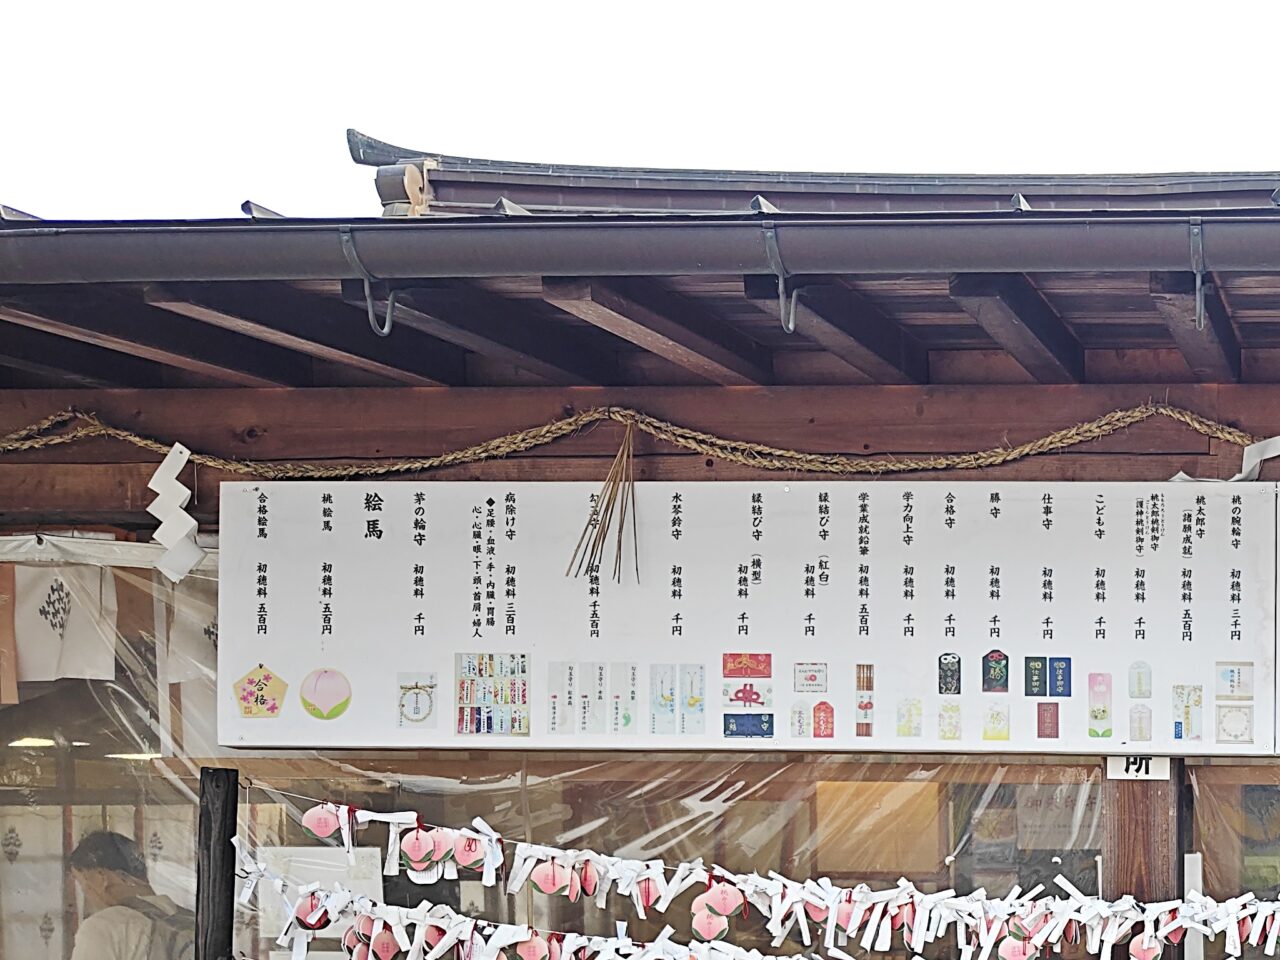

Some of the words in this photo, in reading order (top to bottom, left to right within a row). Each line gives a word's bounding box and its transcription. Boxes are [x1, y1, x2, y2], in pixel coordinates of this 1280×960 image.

[257, 492, 268, 538] 合格絵馬
[322, 493, 333, 531] 桃絵馬
[364, 493, 384, 539] 絵馬
[413, 492, 426, 546] 茅の輪守
[505, 492, 516, 540] 病除け守
[672, 492, 682, 540] 水琴鈴守
[752, 493, 763, 541] 縁結び守
[819, 492, 830, 540] 縁結び守
[902, 492, 913, 545] 学力向上守
[944, 492, 956, 528] 合格守
[990, 492, 1001, 518] 勝守
[1042, 493, 1053, 530] 仕事守
[1094, 495, 1106, 539] こども守
[1196, 496, 1206, 538] 桃太郎守
[1231, 495, 1242, 549] 桃の腕輪守
[858, 493, 870, 556] 学業成就鉛筆
[256, 563, 267, 598] 初穂料
[322, 562, 333, 598] 初穂料
[413, 564, 424, 599] 初穂料
[505, 565, 516, 599] 初穂料
[671, 565, 682, 599] 初穂料
[737, 564, 748, 598] 初穂料
[804, 564, 815, 598] 初穂料
[859, 564, 869, 598] 初穂料
[903, 565, 914, 600] 初穂料
[944, 565, 956, 600] 初穂料
[989, 565, 1000, 600] 初穂料
[1042, 567, 1053, 602] 初穂料
[1095, 568, 1106, 602] 初穂料
[1135, 568, 1146, 602] 初穂料
[1181, 568, 1192, 603] 初穂料
[1230, 569, 1241, 603] 初穂料
[257, 603, 267, 634] 五百円
[321, 602, 332, 635] 五百円
[414, 613, 425, 635] 千円
[505, 603, 516, 635] 三百円
[589, 600, 600, 637] 千五百円
[672, 613, 683, 636] 千円
[738, 612, 748, 635] 千円
[804, 613, 815, 636] 千円
[859, 604, 869, 635] 五百円
[903, 614, 914, 637] 千円
[944, 614, 955, 637] 千円
[989, 615, 1000, 637] 千円
[1042, 617, 1053, 639] 千円
[1095, 616, 1106, 639] 千円
[1135, 617, 1145, 639] 千円
[1182, 609, 1192, 641] 五百円
[1231, 609, 1241, 640] 三千円
[253, 679, 268, 706] 合格
